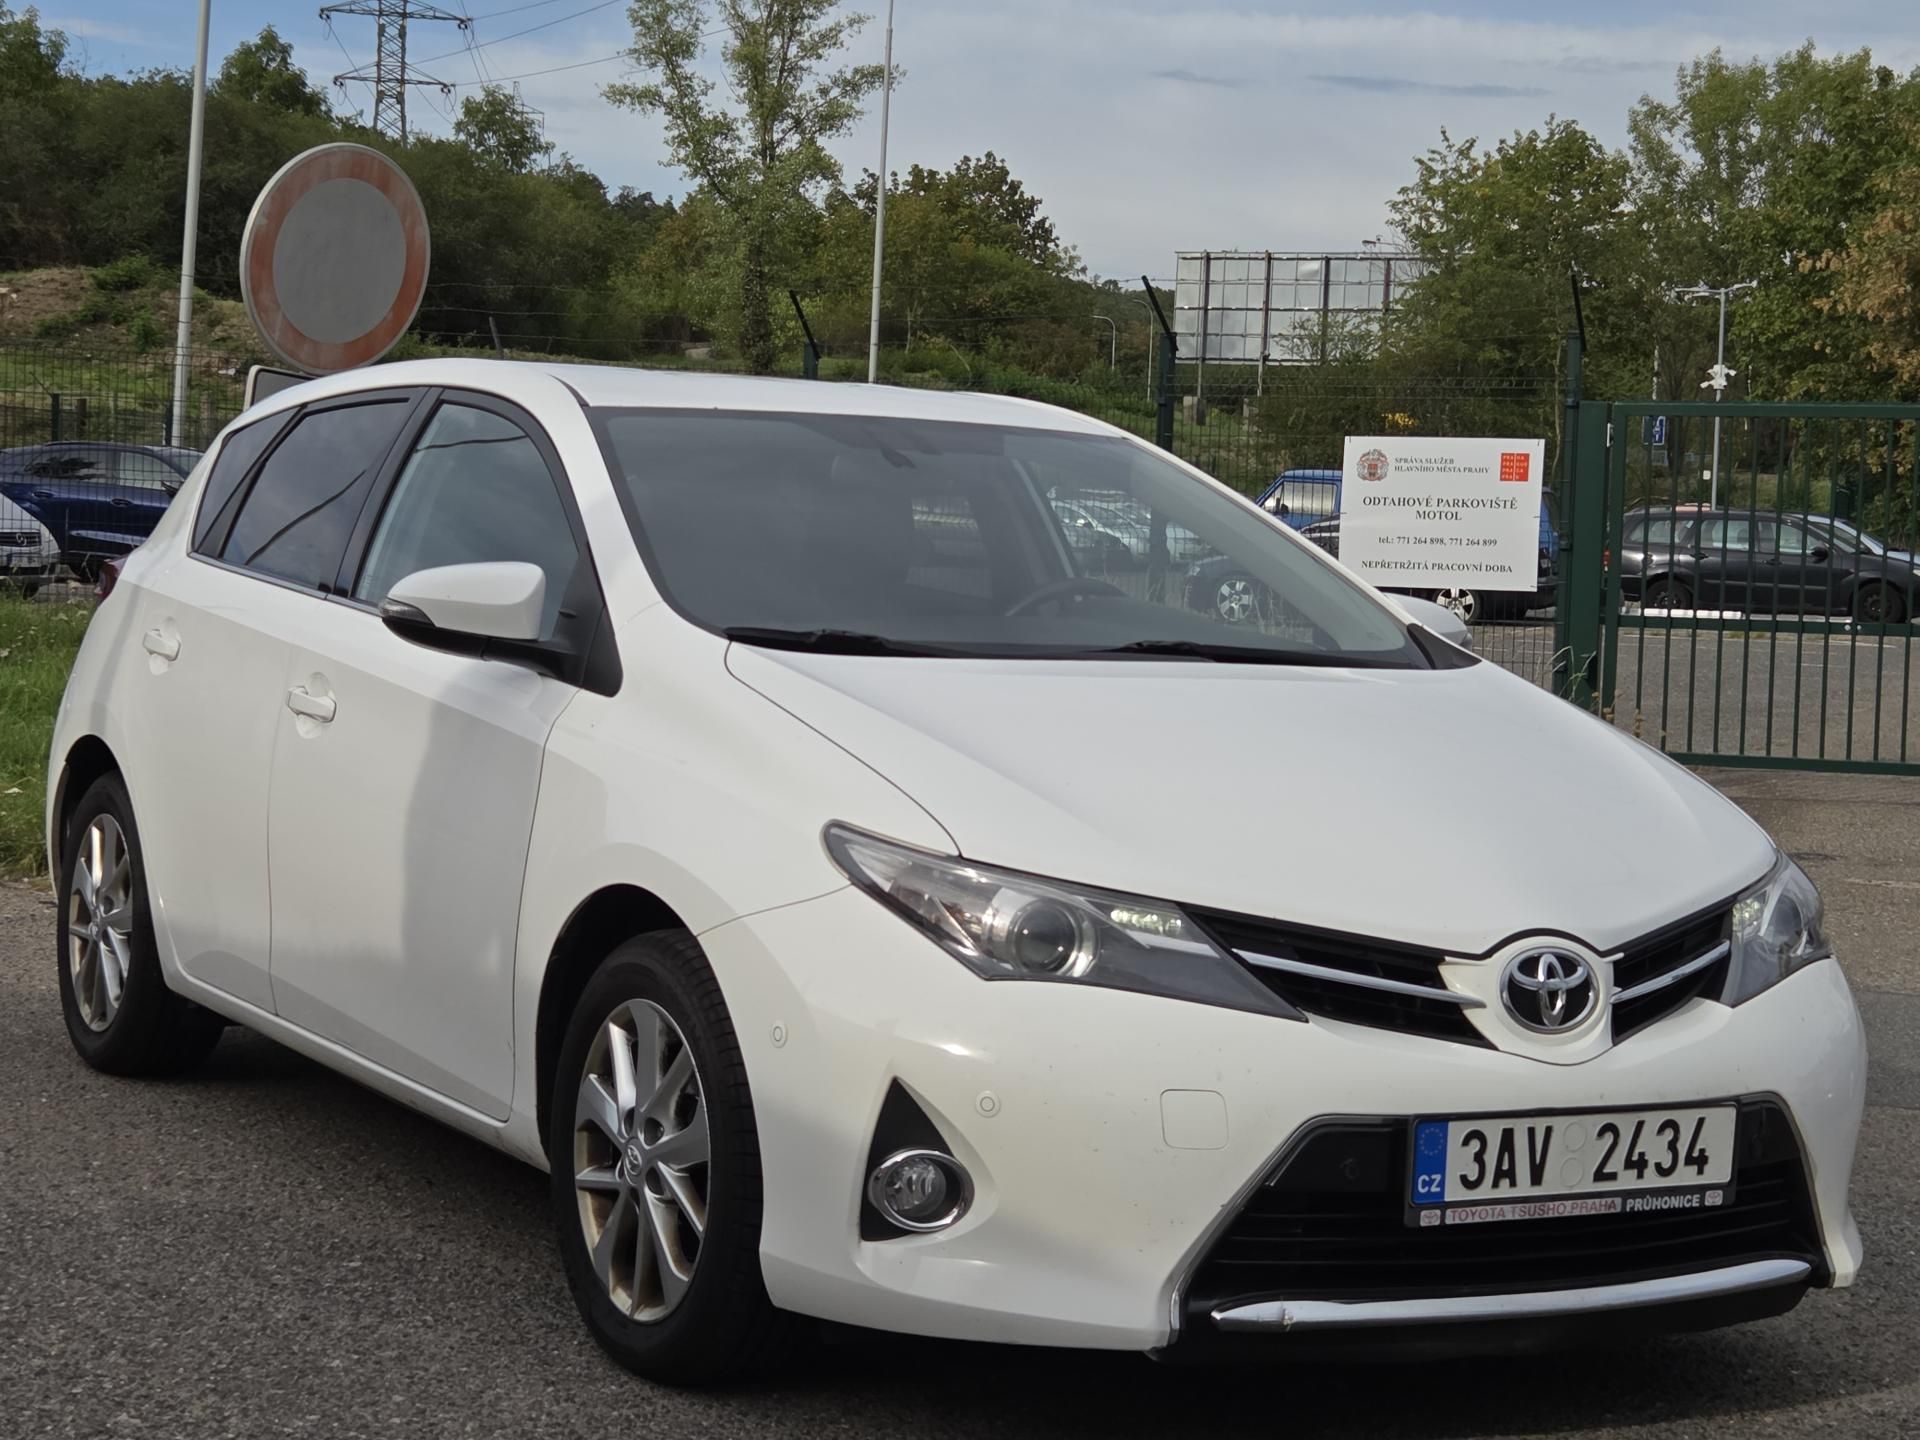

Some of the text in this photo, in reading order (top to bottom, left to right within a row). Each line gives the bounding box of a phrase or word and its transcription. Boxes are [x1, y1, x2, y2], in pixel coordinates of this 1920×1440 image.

[1395, 456, 1455, 465] SPRÁVA SLUŽEB
[1394, 465, 1490, 474] HLAVNÍHO MĚSTA PRAHY
[1362, 495, 1518, 510] ODTAHOVÉ PARKOVIŠTĚ
[1415, 510, 1462, 521] MOTOL
[1378, 536, 1498, 547] tel.: 771 264 898, 771 264 899
[1361, 559, 1513, 573] NEPŘETRŽITÁ PRACOVNÍ DOBA
[1459, 1117, 1709, 1190] 3AV 2434
[1417, 1174, 1442, 1193] CZ
[1626, 1194, 1700, 1212] PRŮHONICE
[1450, 1200, 1617, 1222] TOYOTA TSUSHO PRAHA
